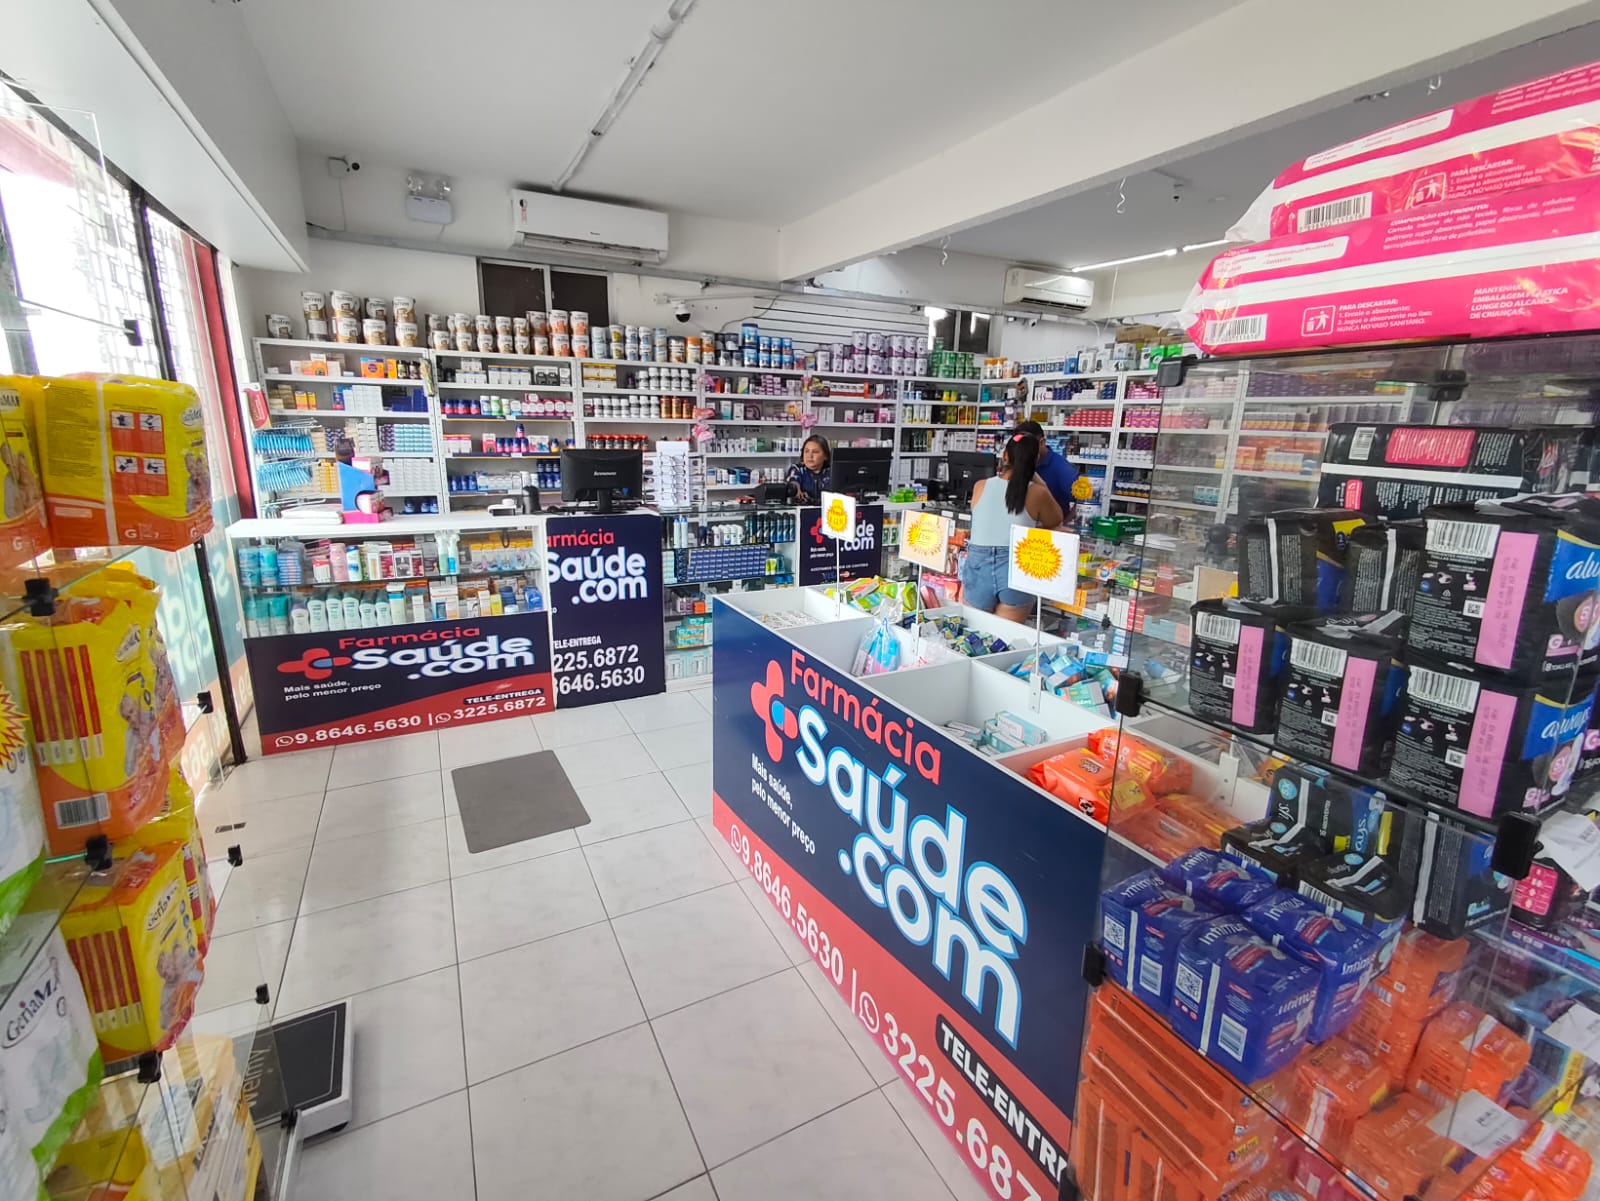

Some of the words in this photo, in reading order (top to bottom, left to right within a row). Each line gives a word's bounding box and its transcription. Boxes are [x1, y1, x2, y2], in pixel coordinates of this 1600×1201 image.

[1339, 303, 1357, 311] PARA
[1471, 303, 1501, 312] LONGE
[1500, 301, 1513, 309] DO
[1472, 292, 1525, 303] EMBALAGEM
[1470, 312, 1481, 320] DE
[547, 528, 615, 547] armácia
[840, 536, 875, 551] .com
[547, 546, 646, 583] Saúde
[571, 575, 648, 605] .com
[338, 626, 480, 650] Farmácia
[351, 634, 534, 671] Saúde
[407, 651, 537, 681] .com
[553, 644, 639, 673] 225.6872
[284, 684, 311, 693] Mais
[313, 679, 350, 692] saúde,
[285, 692, 310, 702] pelo
[312, 687, 349, 698] menor
[351, 682, 382, 694] preço
[465, 688, 543, 705] TELE-ENTREGA
[453, 696, 547, 720] 3225.6872
[790, 649, 941, 785] Farmácia
[294, 714, 422, 745] 9.8646.5630
[752, 753, 768, 783] Mais
[768, 773, 793, 811] saúde,
[751, 778, 767, 803] pelo
[767, 795, 790, 827] menor
[791, 820, 816, 855] preço
[795, 704, 1028, 960] Saúde
[742, 834, 845, 986] 9.8646.5630
[838, 833, 1022, 1051] .com
[883, 1011, 1041, 1201] 3225.687
[941, 1022, 1068, 1184] TELE-ENTR
